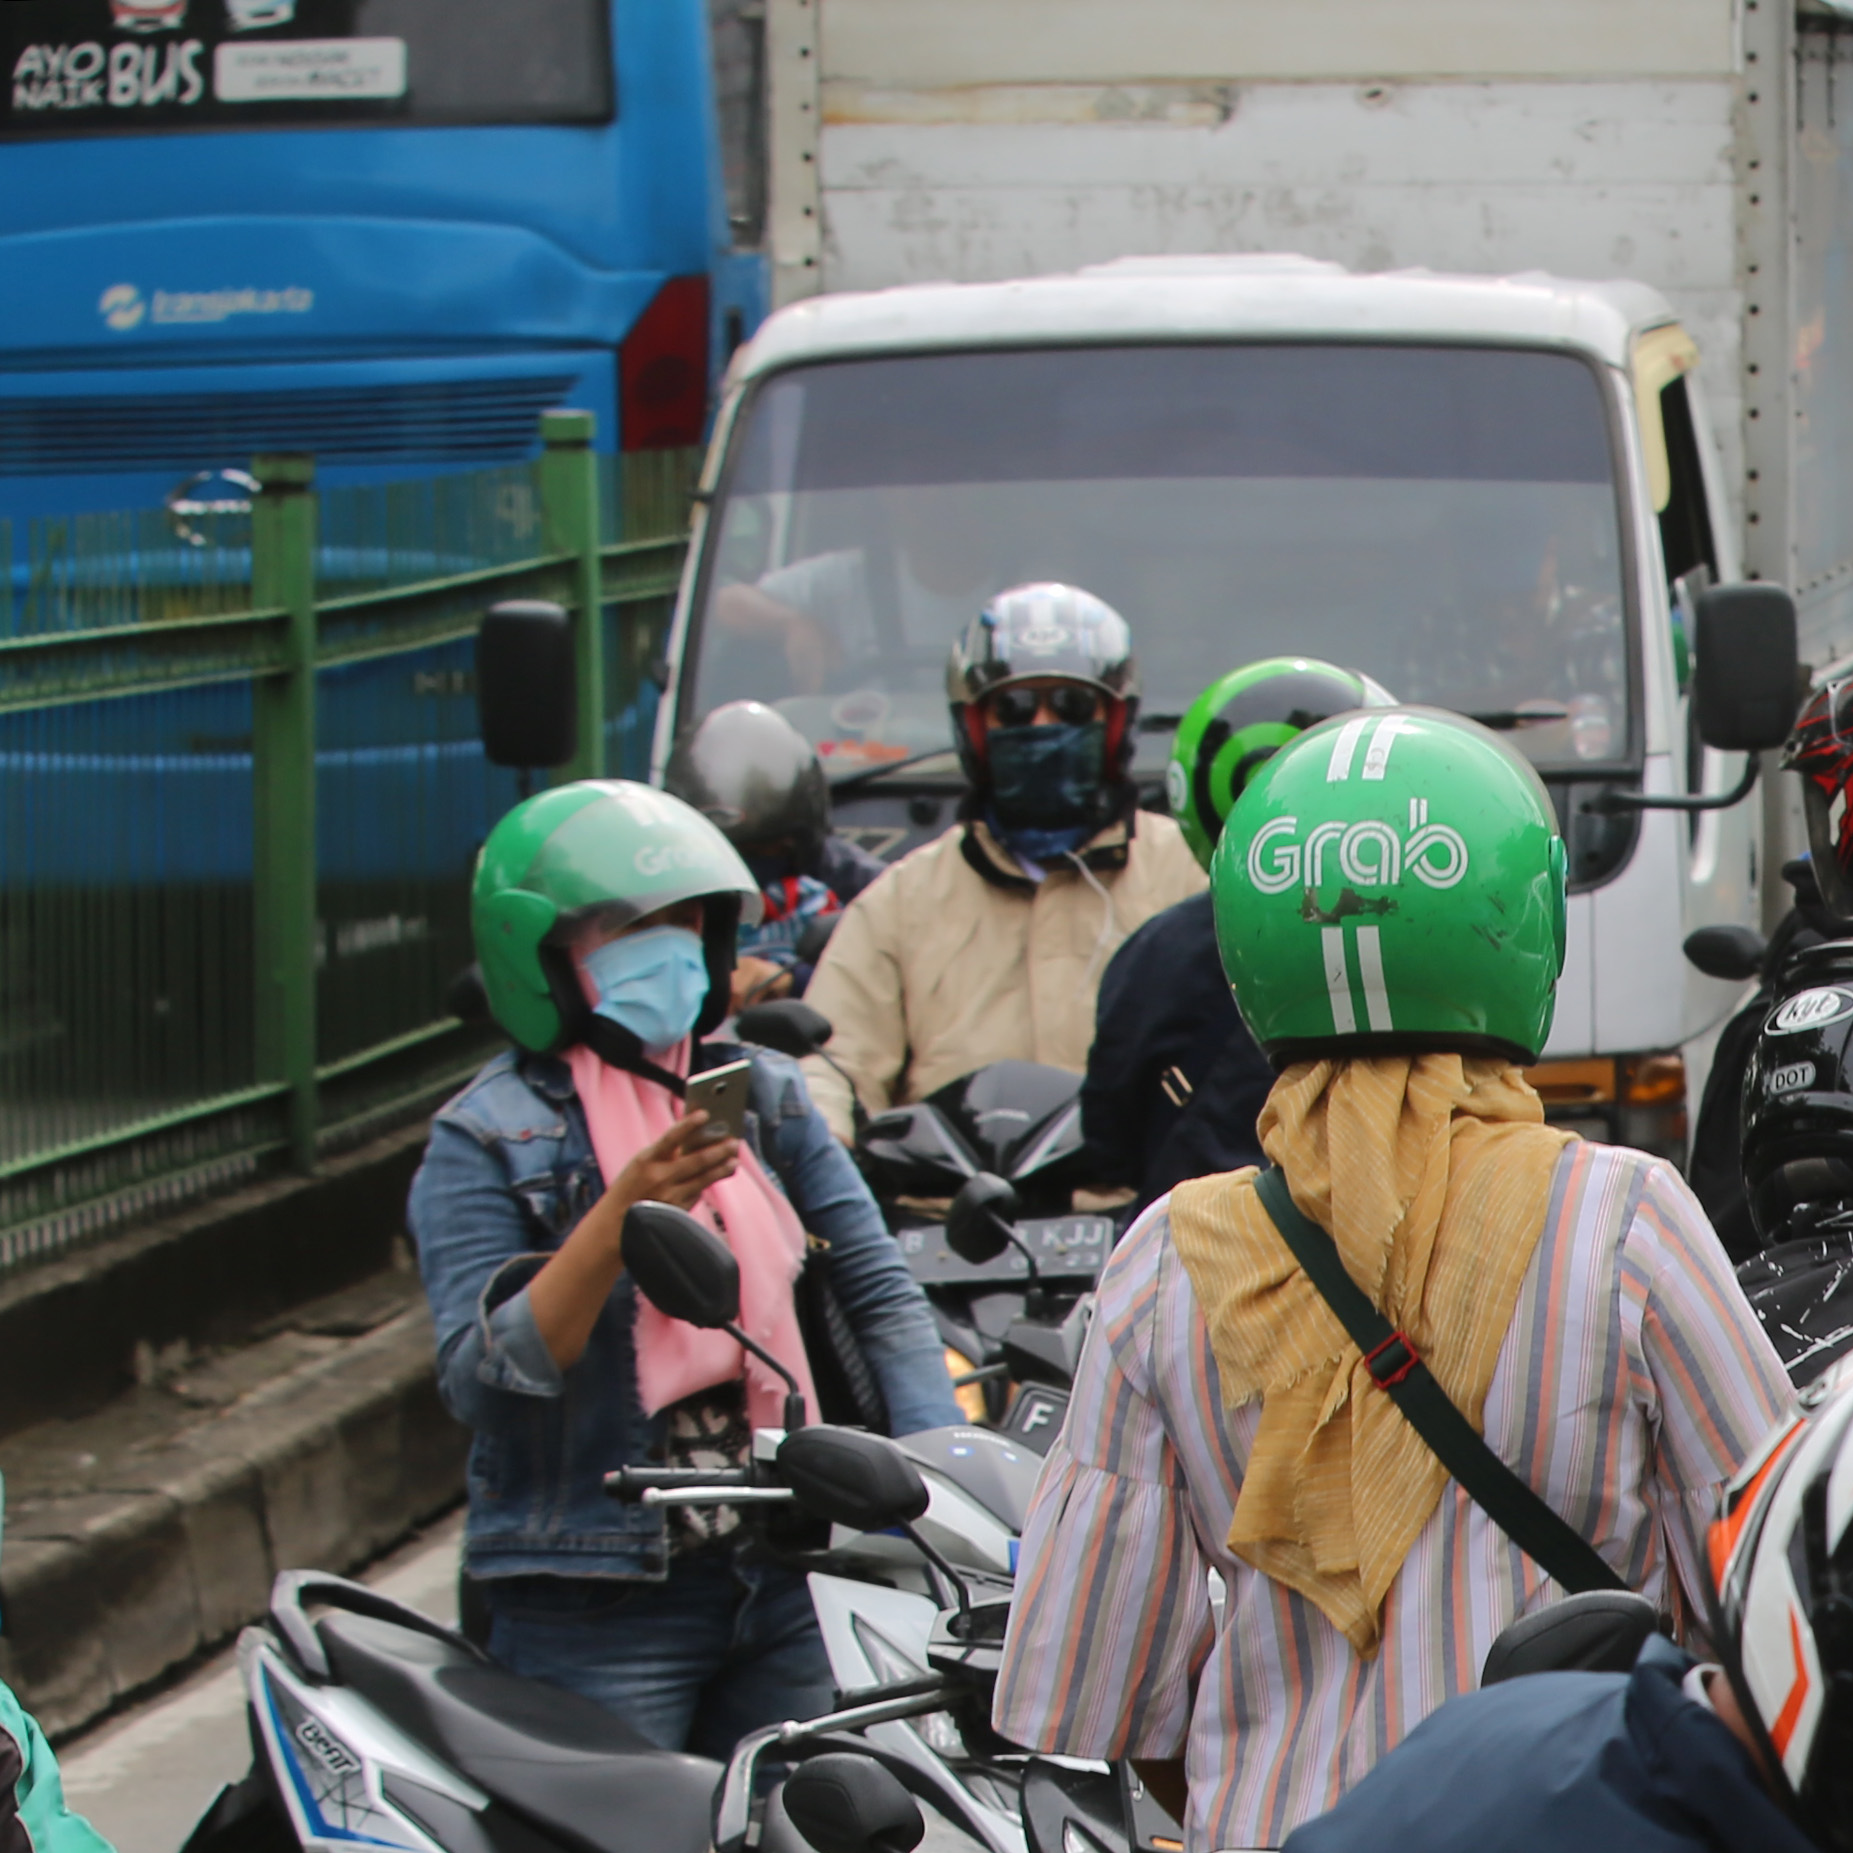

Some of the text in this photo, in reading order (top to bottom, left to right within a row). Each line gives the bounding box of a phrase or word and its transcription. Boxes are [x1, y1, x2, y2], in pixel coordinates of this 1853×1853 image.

[13, 42, 103, 80] AYO
[108, 39, 203, 106] BUS
[13, 79, 106, 109] NAIK
[1247, 797, 1469, 895] Grab
[1775, 1065, 1808, 1091] DOT
